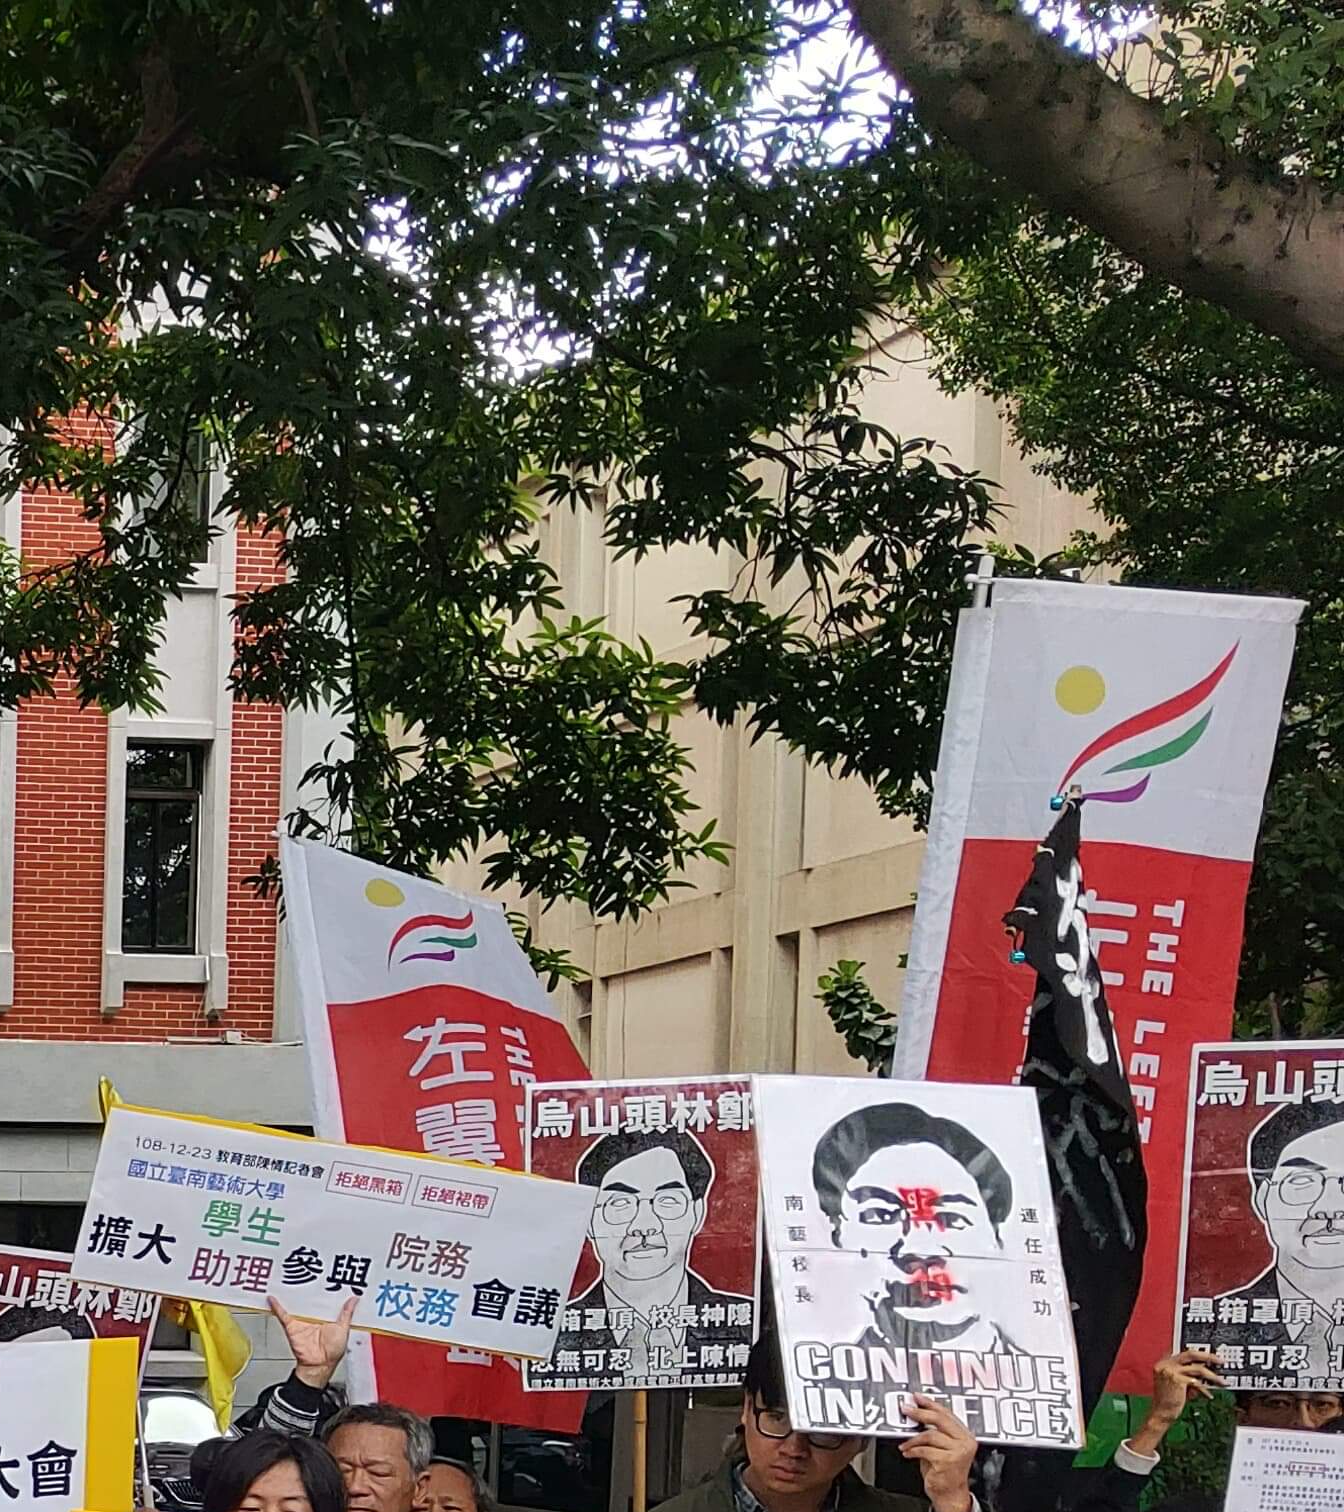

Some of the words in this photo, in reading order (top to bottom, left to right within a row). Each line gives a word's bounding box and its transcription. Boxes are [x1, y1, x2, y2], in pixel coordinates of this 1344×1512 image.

[1141, 899, 1186, 997] THE
[532, 1090, 754, 1138] 烏山頭林鄭
[127, 1158, 286, 1201] 國立臺南藝術大學
[134, 1135, 212, 1162] 108-12-23
[216, 1148, 325, 1180] 教育部陳情記者會
[335, 1169, 405, 1198] 拒絕黑箱
[419, 1184, 491, 1211] 拒絕裙帶
[201, 1199, 287, 1248] 學生
[87, 1213, 178, 1265] 擴大
[280, 1244, 370, 1297] 參與
[471, 1277, 563, 1329] 會議
[187, 1246, 274, 1294] 助理
[385, 1231, 474, 1280] 院務
[783, 1194, 814, 1305] 南藝校長
[1019, 1206, 1053, 1318] 連任成功
[375, 1278, 462, 1330] 校務
[561, 1307, 635, 1332] 箱罩頂
[648, 1303, 752, 1328] 校長神隱
[1186, 1297, 1314, 1326] 黑箱罩頂
[648, 1344, 751, 1371] 北上陳情
[794, 1341, 1069, 1396] CONTINUE
[802, 1386, 864, 1427] IN
[884, 1388, 1072, 1443] OFICE
